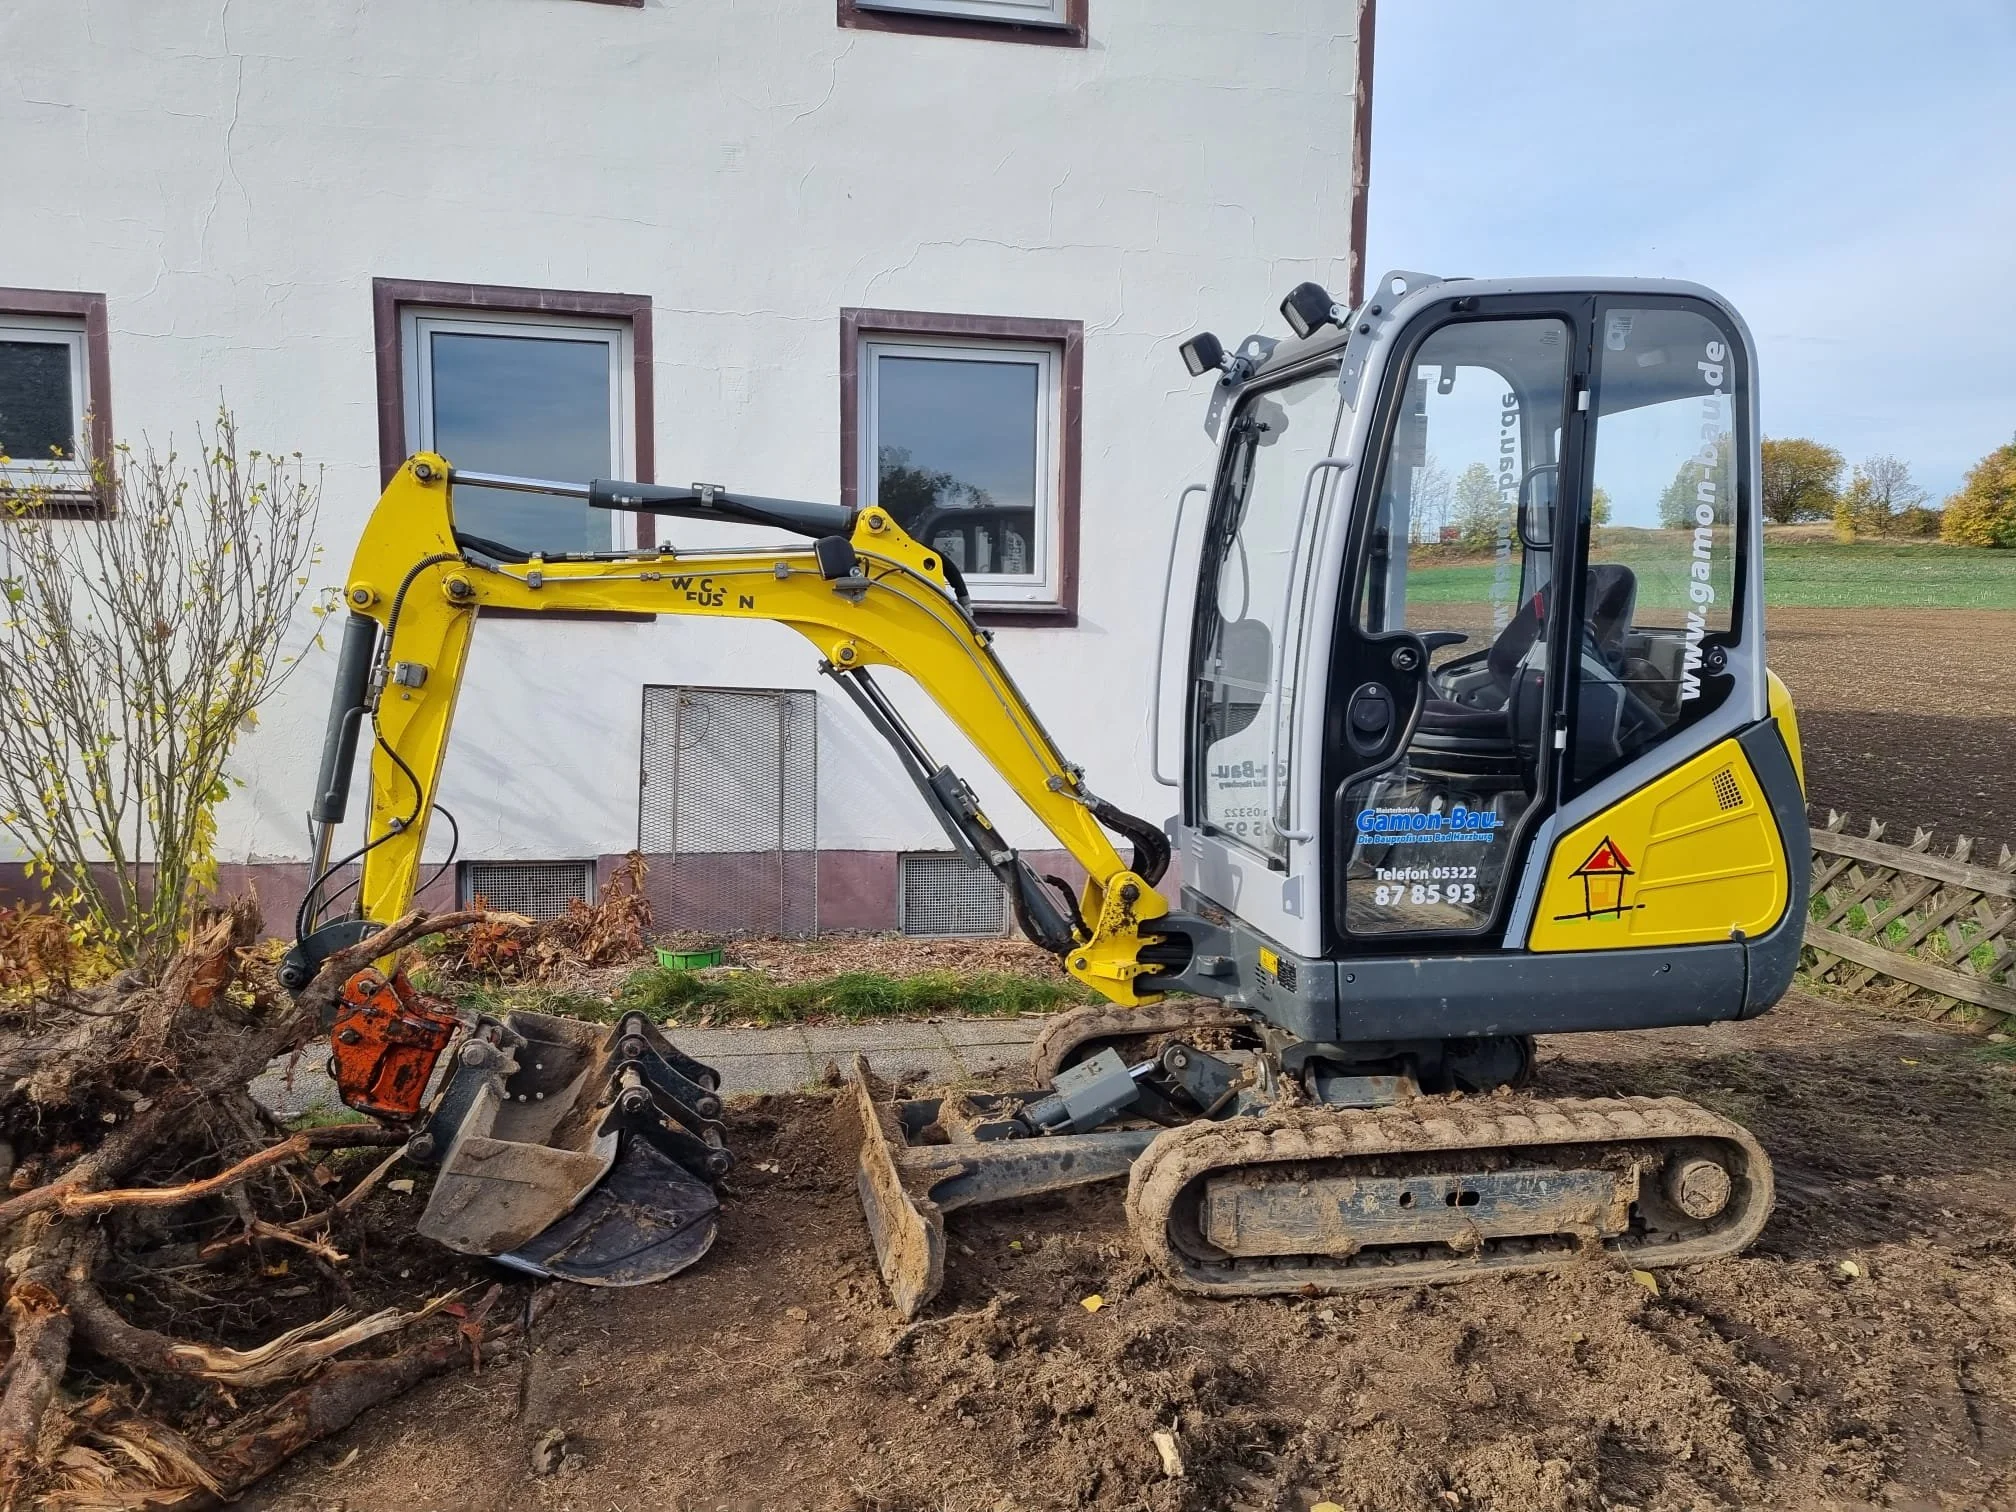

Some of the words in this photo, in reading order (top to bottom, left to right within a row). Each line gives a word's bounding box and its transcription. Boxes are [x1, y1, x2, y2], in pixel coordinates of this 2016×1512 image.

[1681, 340, 1727, 701] www.gamon-bau.de
[1356, 806, 1497, 832] Gamon-Bau
[1358, 834, 1372, 844] Die
[1374, 833, 1416, 845] Bauprofis
[1418, 834, 1433, 843] aus
[1434, 832, 1451, 843] Bad
[1376, 867, 1429, 881] Telefon
[1432, 866, 1477, 880] 05322
[1375, 886, 1405, 905] 87
[1411, 884, 1441, 905] 85
[1446, 883, 1476, 904] 93
